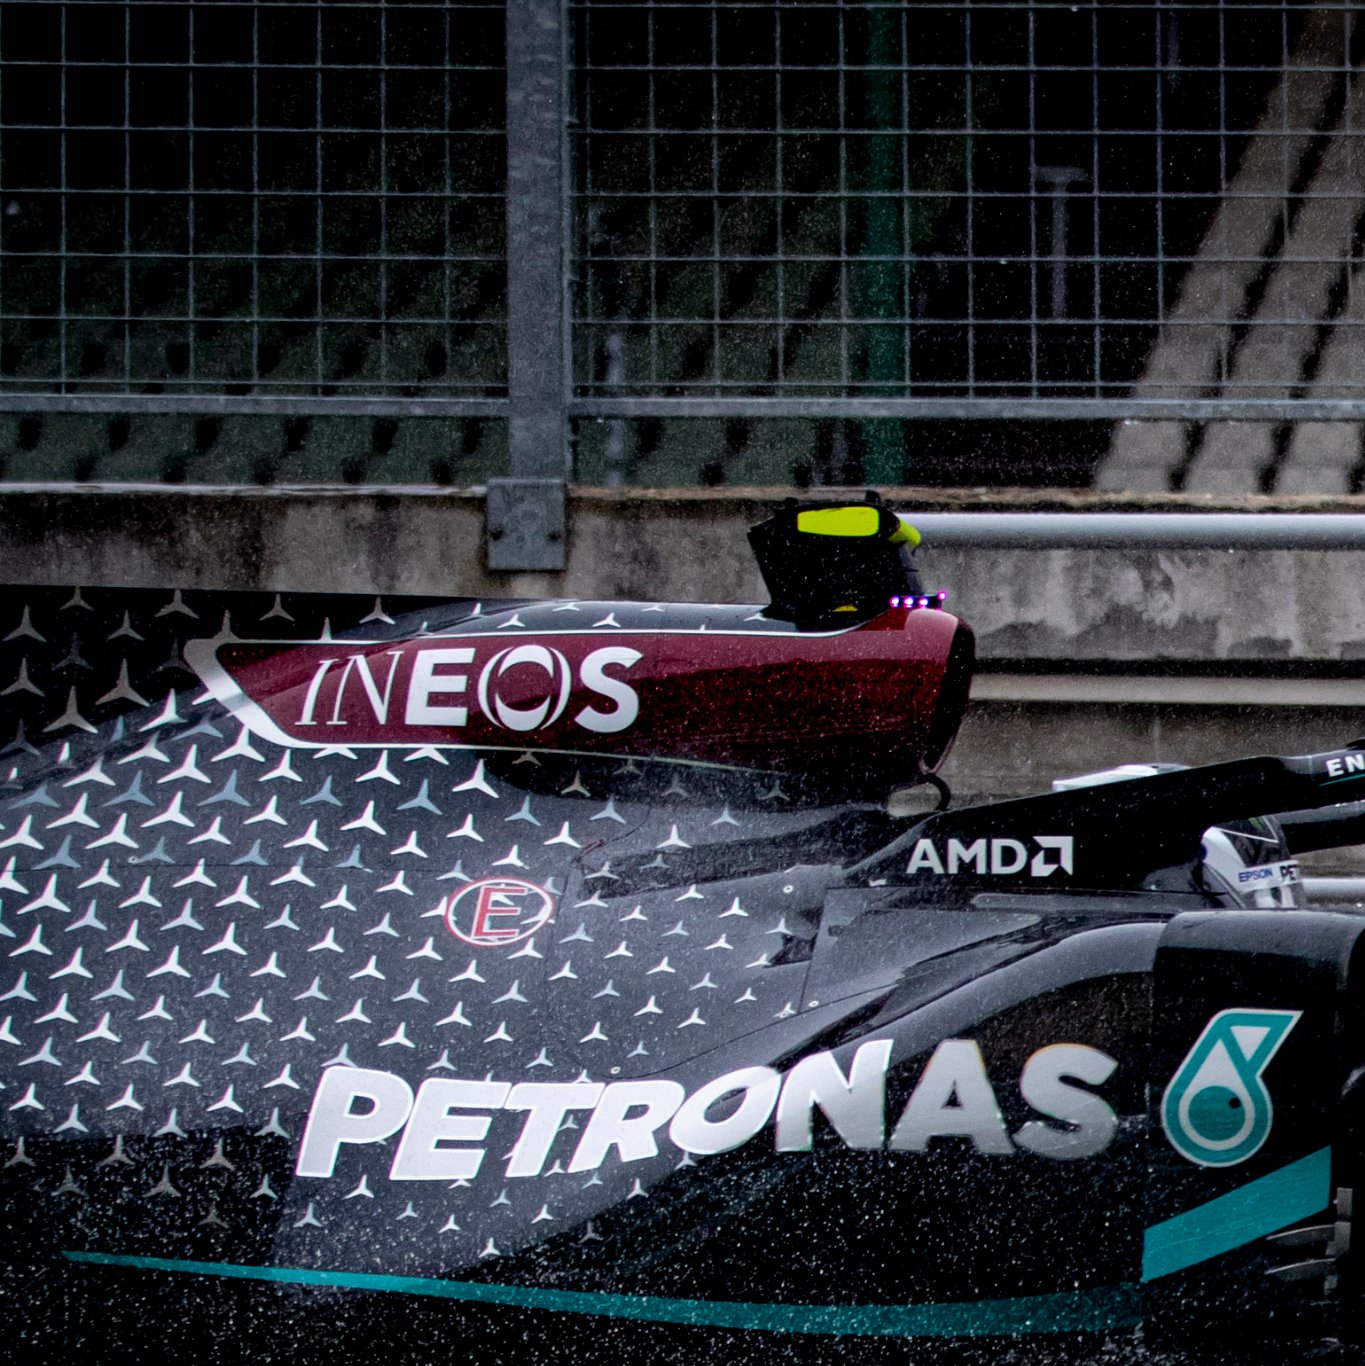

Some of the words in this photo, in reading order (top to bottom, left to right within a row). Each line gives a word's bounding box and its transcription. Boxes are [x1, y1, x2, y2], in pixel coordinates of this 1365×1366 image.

[294, 643, 643, 733] INEOS
[905, 837, 1029, 876] AMD
[1238, 867, 1274, 883] EPSON
[295, 1037, 1120, 1181] PETRONAS
